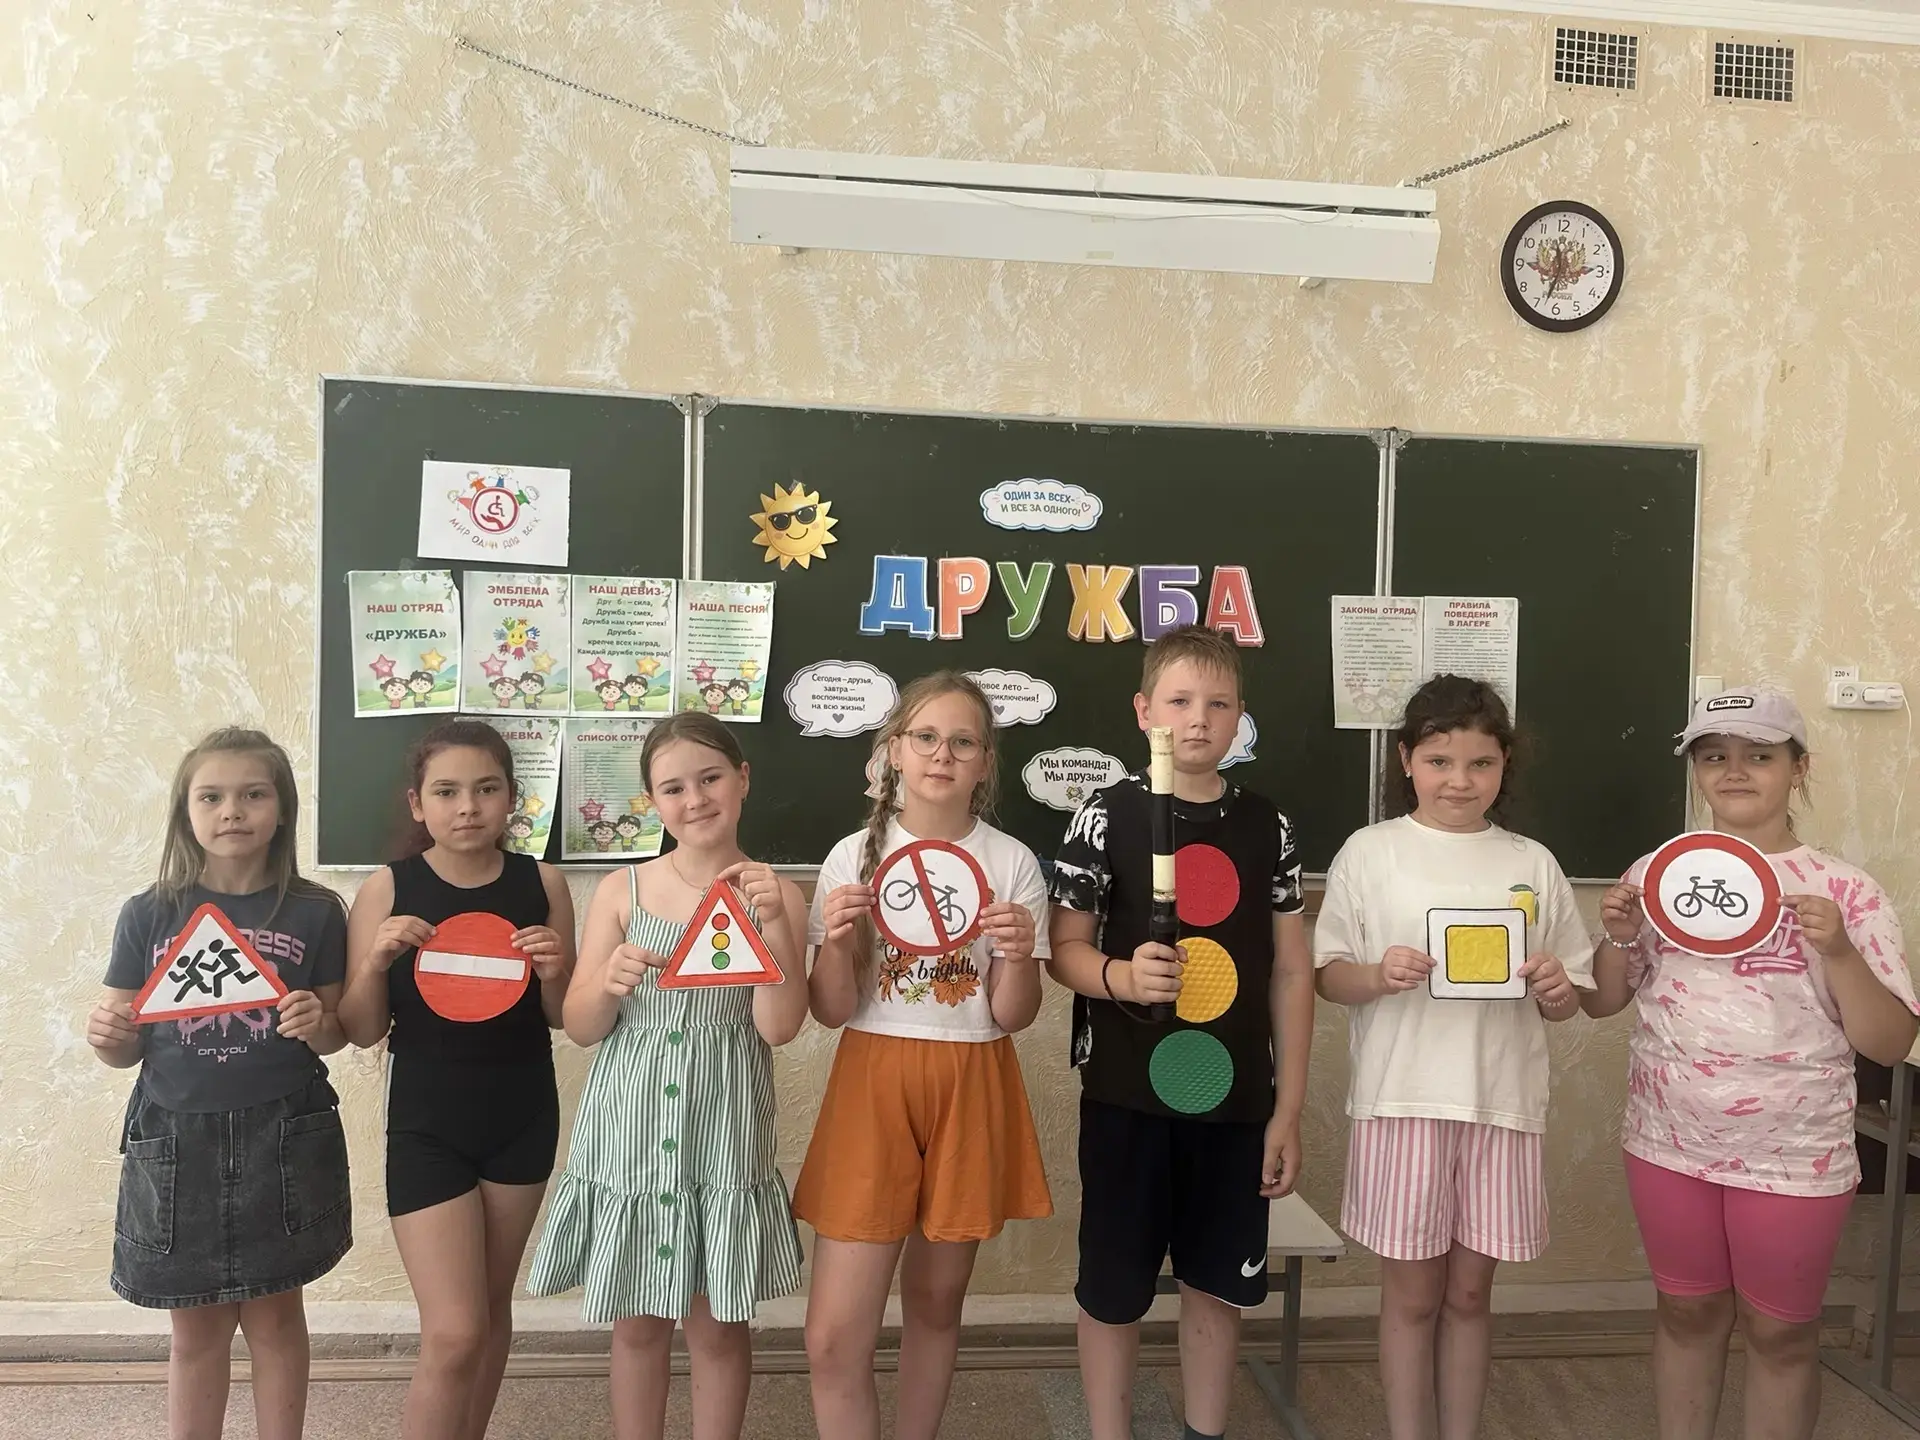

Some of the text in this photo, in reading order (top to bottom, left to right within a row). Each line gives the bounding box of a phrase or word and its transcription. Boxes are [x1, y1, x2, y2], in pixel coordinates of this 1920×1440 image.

[1540, 223, 1547, 235] 11
[1558, 219, 1571, 233] 12
[1524, 237, 1536, 249] 10
[1593, 244, 1601, 256] 2
[1515, 258, 1525, 271] 9
[1596, 265, 1605, 278] 3
[1519, 281, 1528, 293] 8
[1588, 287, 1596, 298] 4
[1533, 297, 1541, 308] 7
[1572, 301, 1581, 312] 5
[1551, 302, 1561, 315] 6
[1003, 491, 1031, 502] ОДИН
[1034, 491, 1046, 501] ЗА
[1001, 503, 1081, 517] И ВСЕ ЗА ОДНОГО!
[487, 585, 550, 596] ЭМБЛЕМА
[588, 585, 617, 594] НАШ
[493, 597, 544, 608] ОТРЯДА
[860, 555, 1265, 648] ДРУЖБА
[367, 603, 444, 614] НАШ ОТРЯД
[596, 608, 626, 616] Дружба
[633, 609, 654, 618] смех,
[689, 603, 766, 613] НАША ПЕСНЯ
[1340, 606, 1417, 616] ЗАКОНЫ ОТРЯДА
[1444, 611, 1499, 619] ПОВЕДЕНИЯ
[582, 618, 610, 626] Дружба
[365, 628, 447, 642] «ДРУЖБА»
[607, 628, 636, 637] Дружба
[587, 639, 614, 647] крепче
[811, 673, 842, 683] Сегодня
[847, 677, 873, 685] друзья,
[1002, 683, 1022, 691] лето
[811, 694, 865, 702] воспоминания
[577, 734, 646, 742] СПИСОК ОТРЯ
[1039, 757, 1111, 771] Мы команда!
[1044, 771, 1107, 784] Мы друзья!
